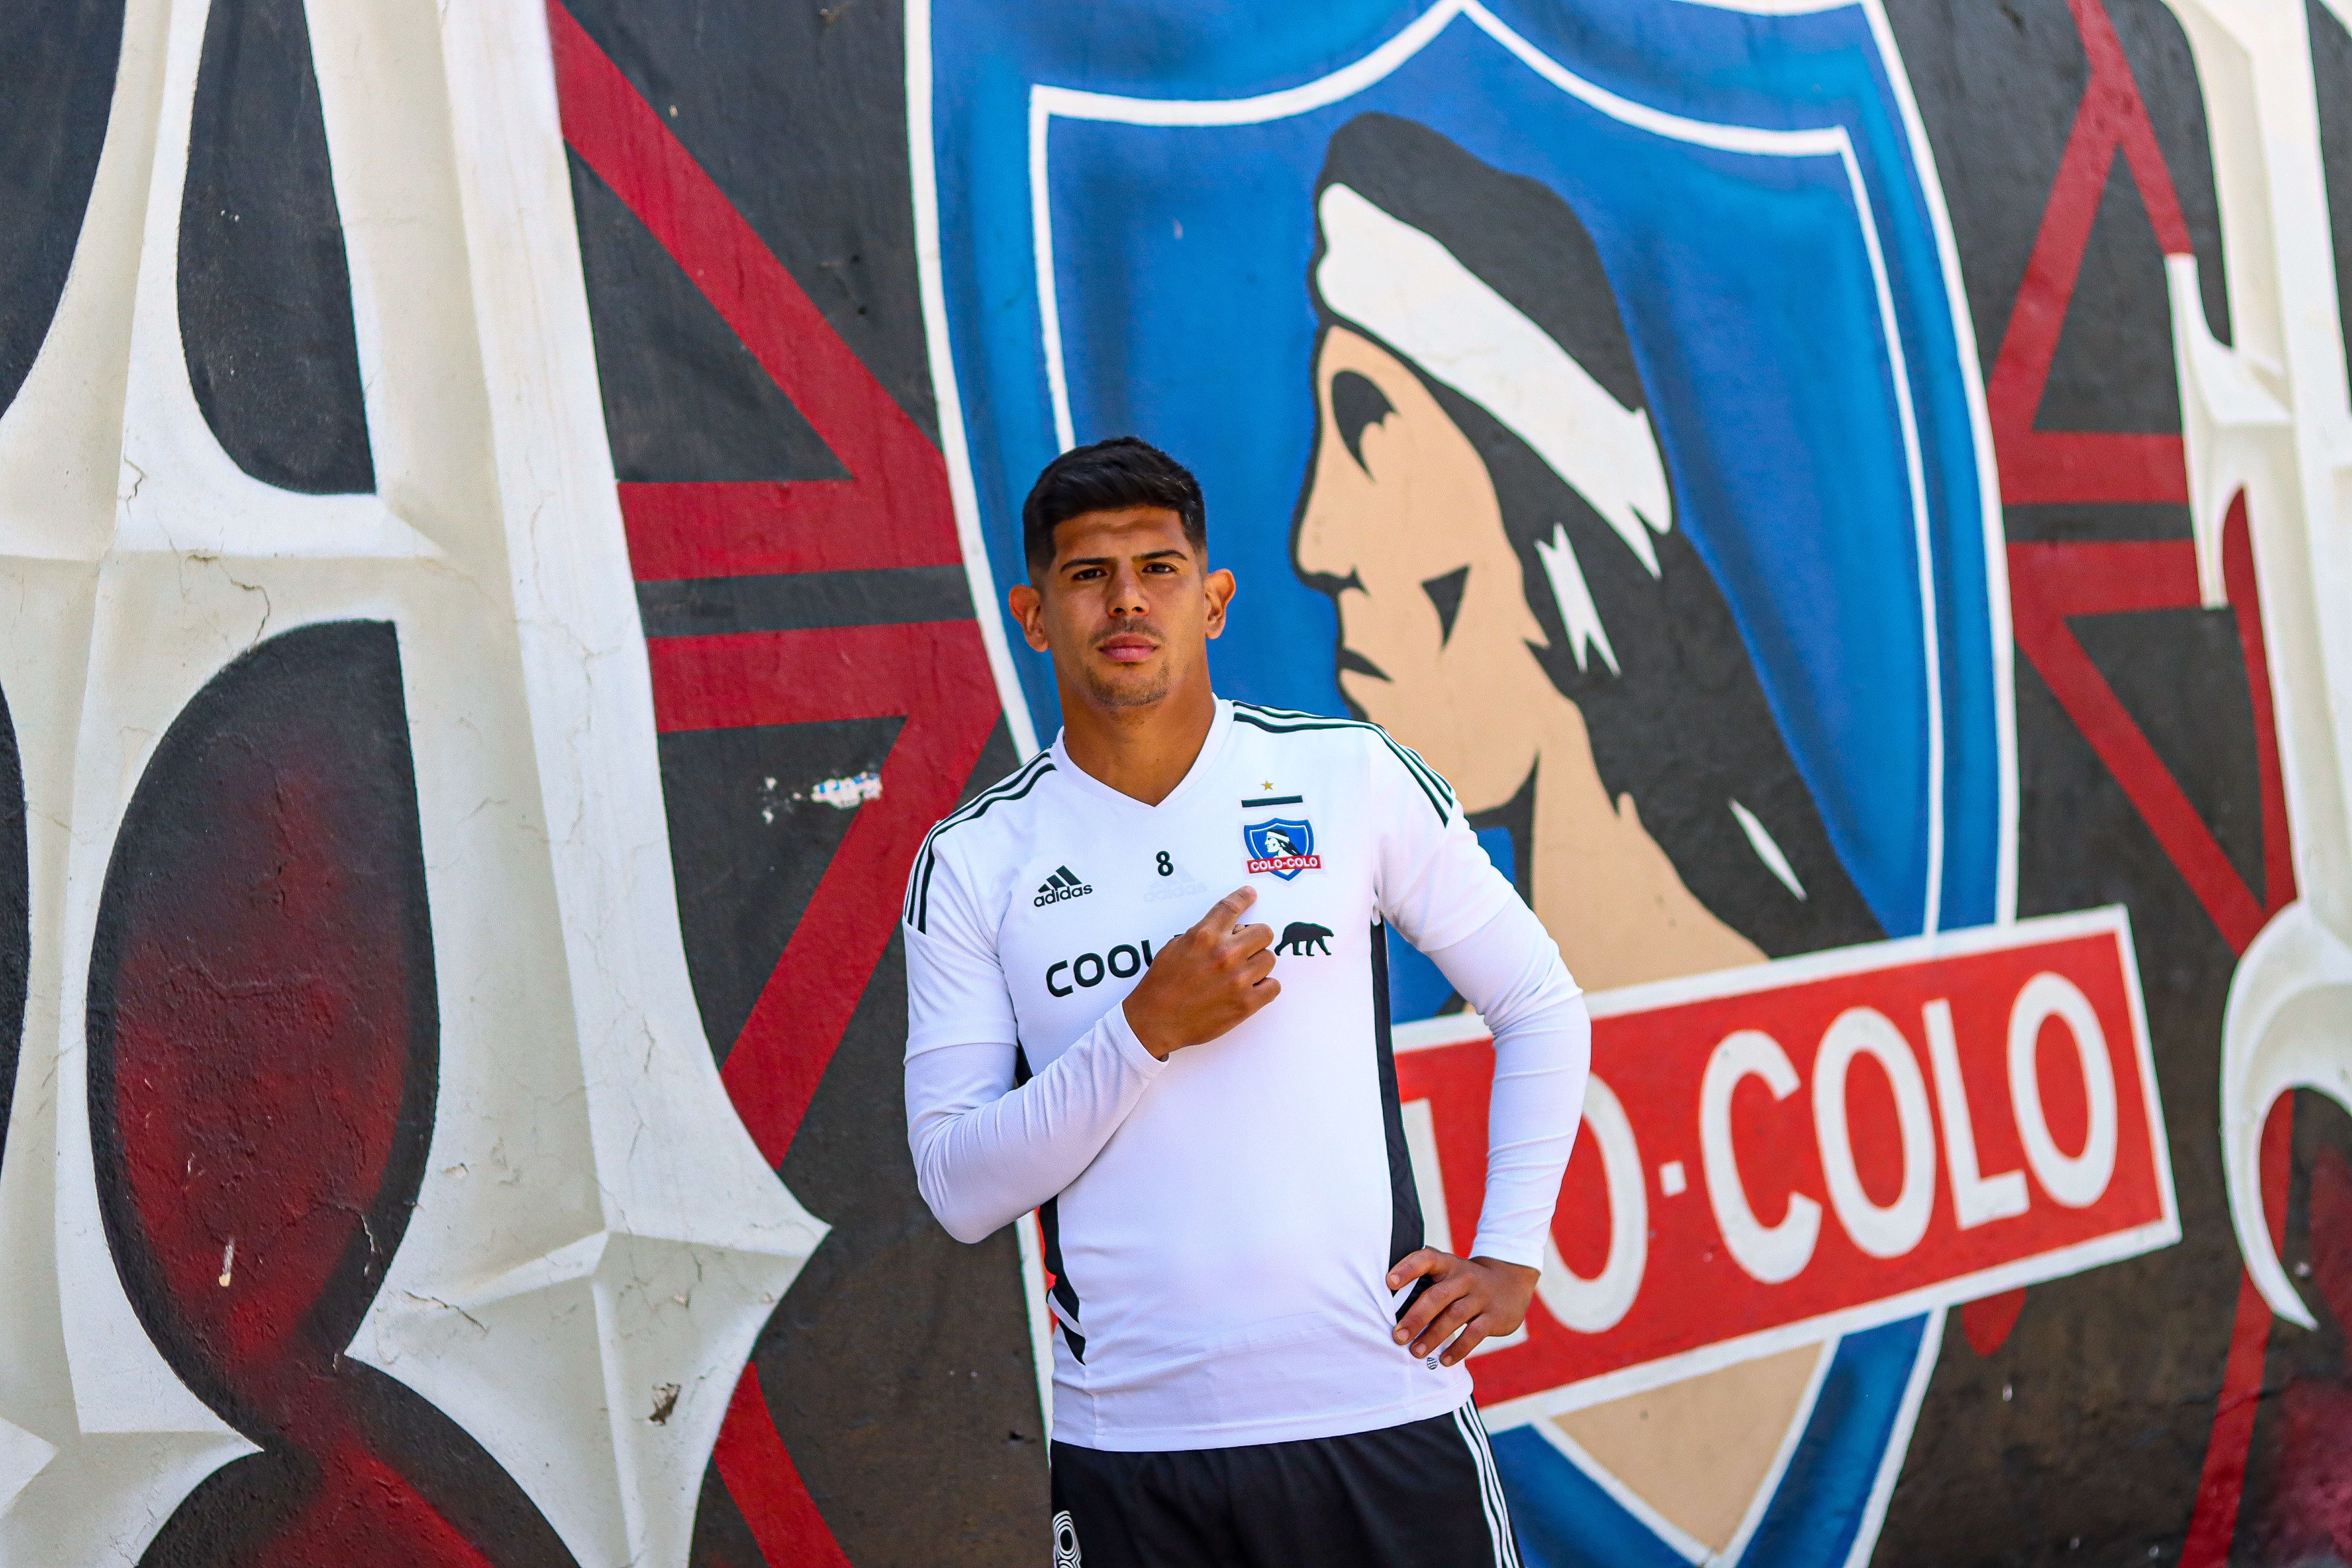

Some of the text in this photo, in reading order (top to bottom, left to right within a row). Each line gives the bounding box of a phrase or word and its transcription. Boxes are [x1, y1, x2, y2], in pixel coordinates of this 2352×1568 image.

[1156, 851, 1174, 877] 8
[1250, 857, 1318, 871] COLO-COLO
[1034, 884, 1093, 907] adidas
[1046, 932, 1186, 998] COOL
